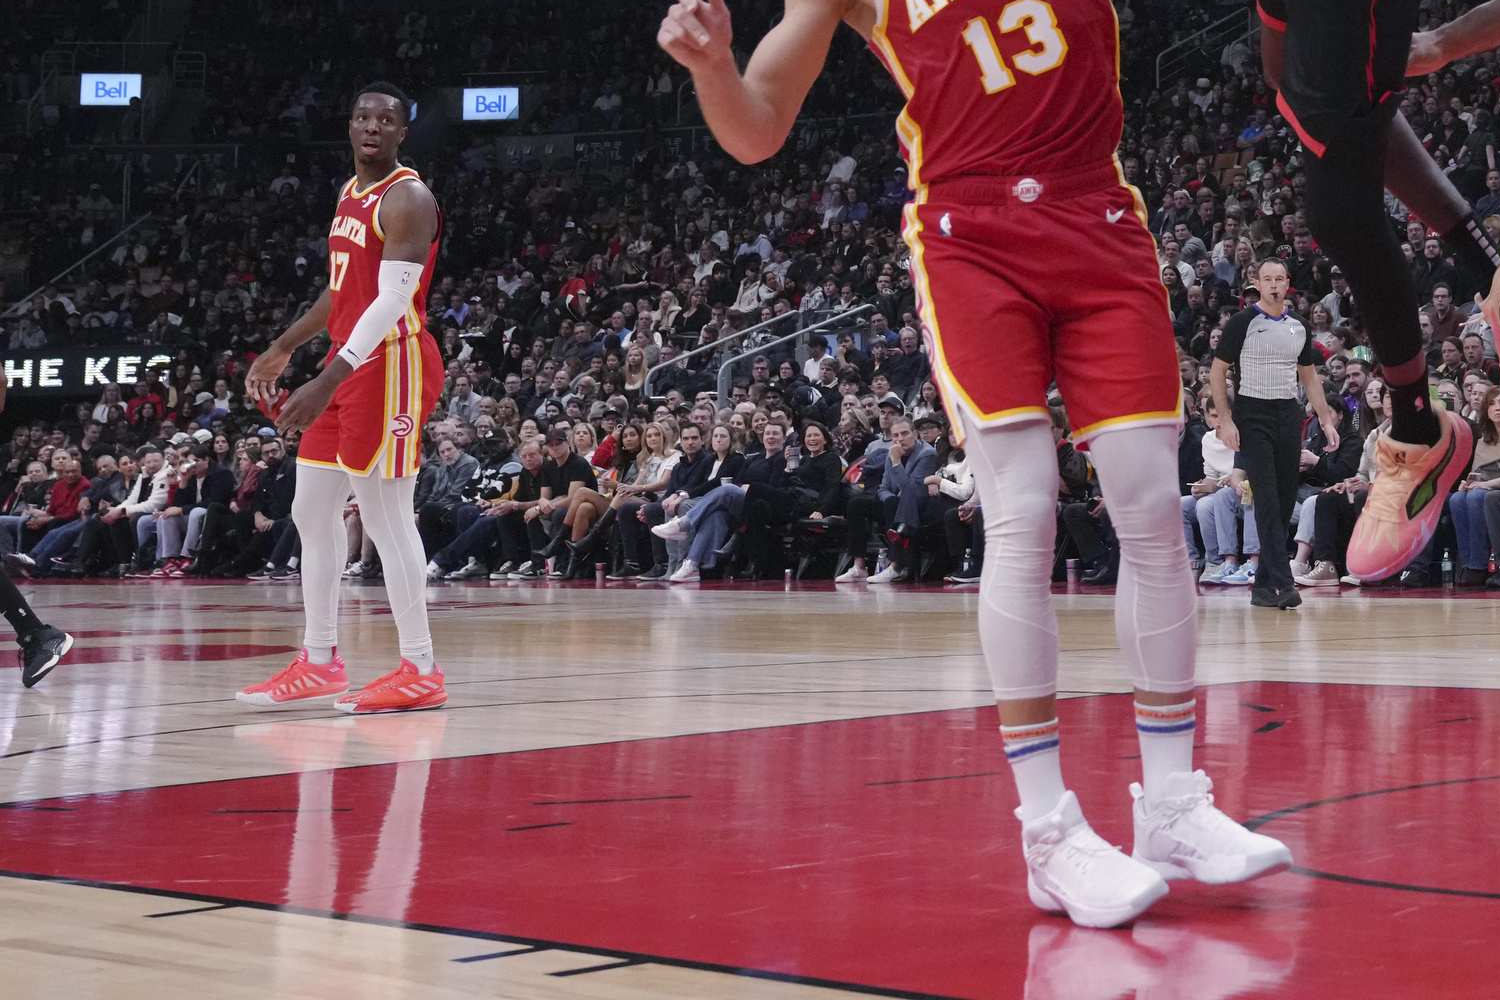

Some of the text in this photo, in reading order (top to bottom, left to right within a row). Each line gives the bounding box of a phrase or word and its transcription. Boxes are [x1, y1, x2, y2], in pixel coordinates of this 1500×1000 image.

[95, 81, 127, 98] Bell
[475, 95, 507, 113] Bell
[1012, 183, 1044, 197] HAWKS
[329, 215, 367, 249] TLANTA
[330, 251, 350, 291] 17
[4, 358, 64, 388] HE
